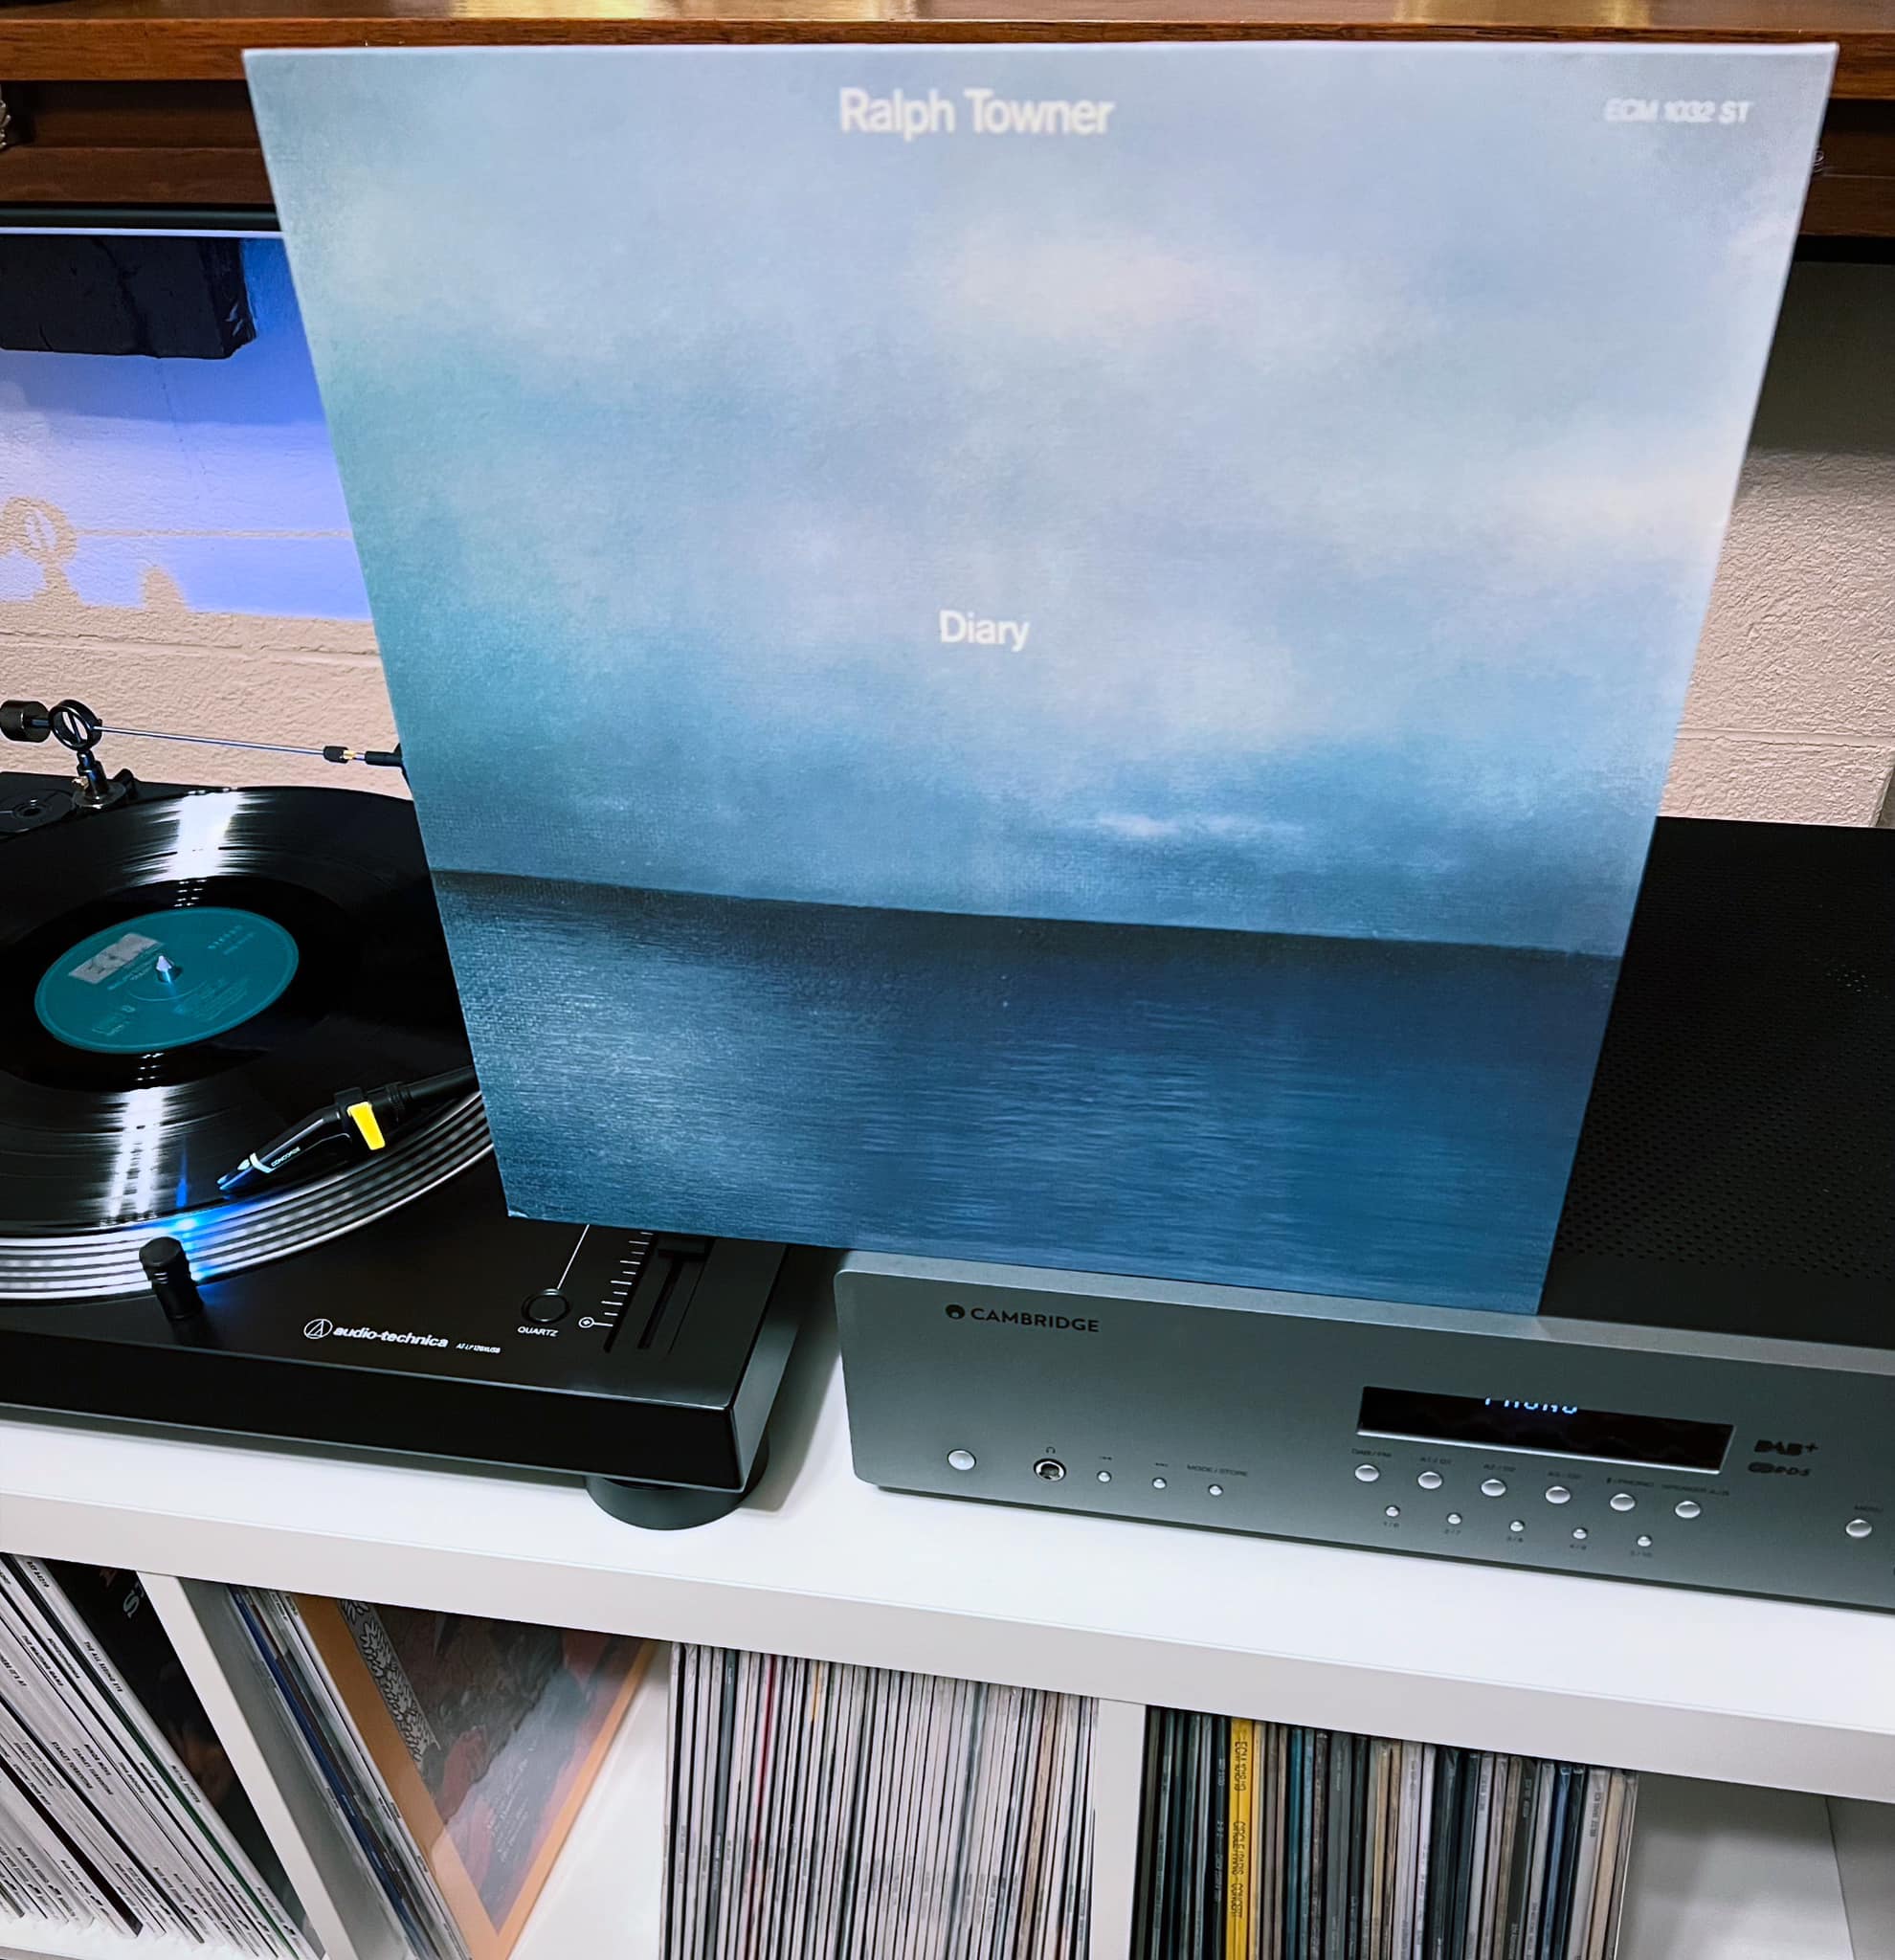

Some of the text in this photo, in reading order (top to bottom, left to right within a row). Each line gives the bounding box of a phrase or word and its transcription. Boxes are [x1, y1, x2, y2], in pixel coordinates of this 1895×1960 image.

[838, 86, 1115, 142] Ralph Towner
[1604, 98, 1659, 122] ECM
[1719, 100, 1750, 124] ST
[939, 609, 1030, 653] Diary
[517, 1325, 559, 1338] QUARTZ
[970, 1307, 1100, 1332] CAMBRIDGE
[333, 1325, 449, 1348] audio-technica
